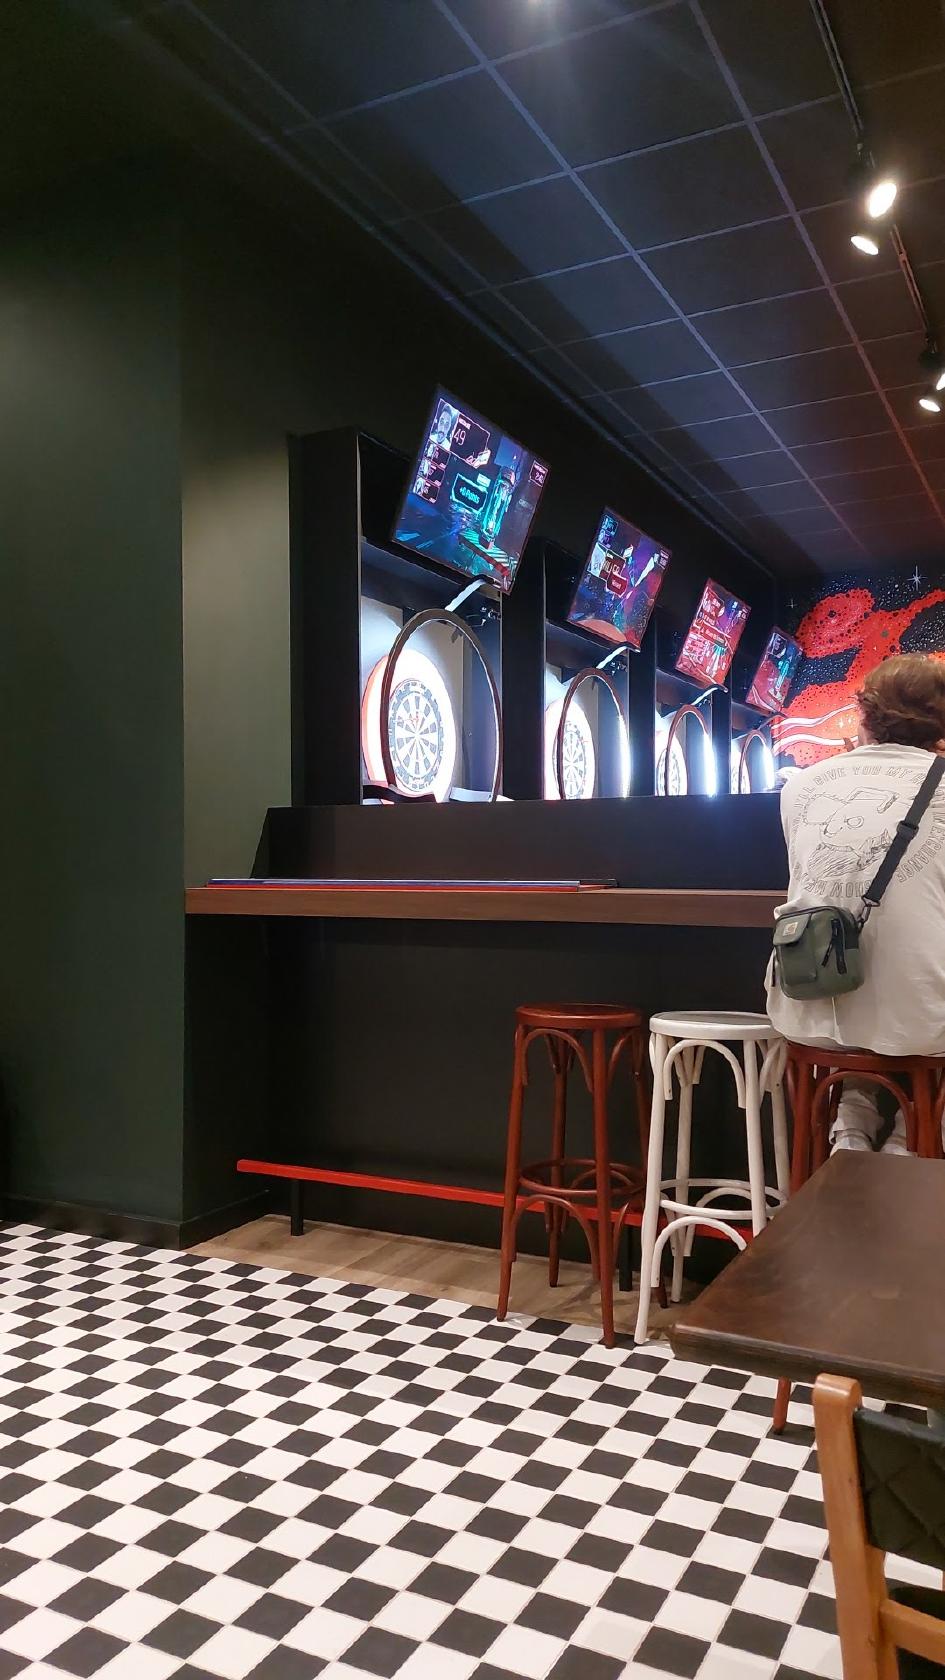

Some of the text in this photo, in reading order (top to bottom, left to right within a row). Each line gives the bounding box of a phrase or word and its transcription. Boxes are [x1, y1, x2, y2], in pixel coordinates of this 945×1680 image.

[453, 429, 466, 445] 49
[814, 767, 847, 786] GIVE
[853, 766, 882, 776] YOU
[886, 766, 913, 780] MY
